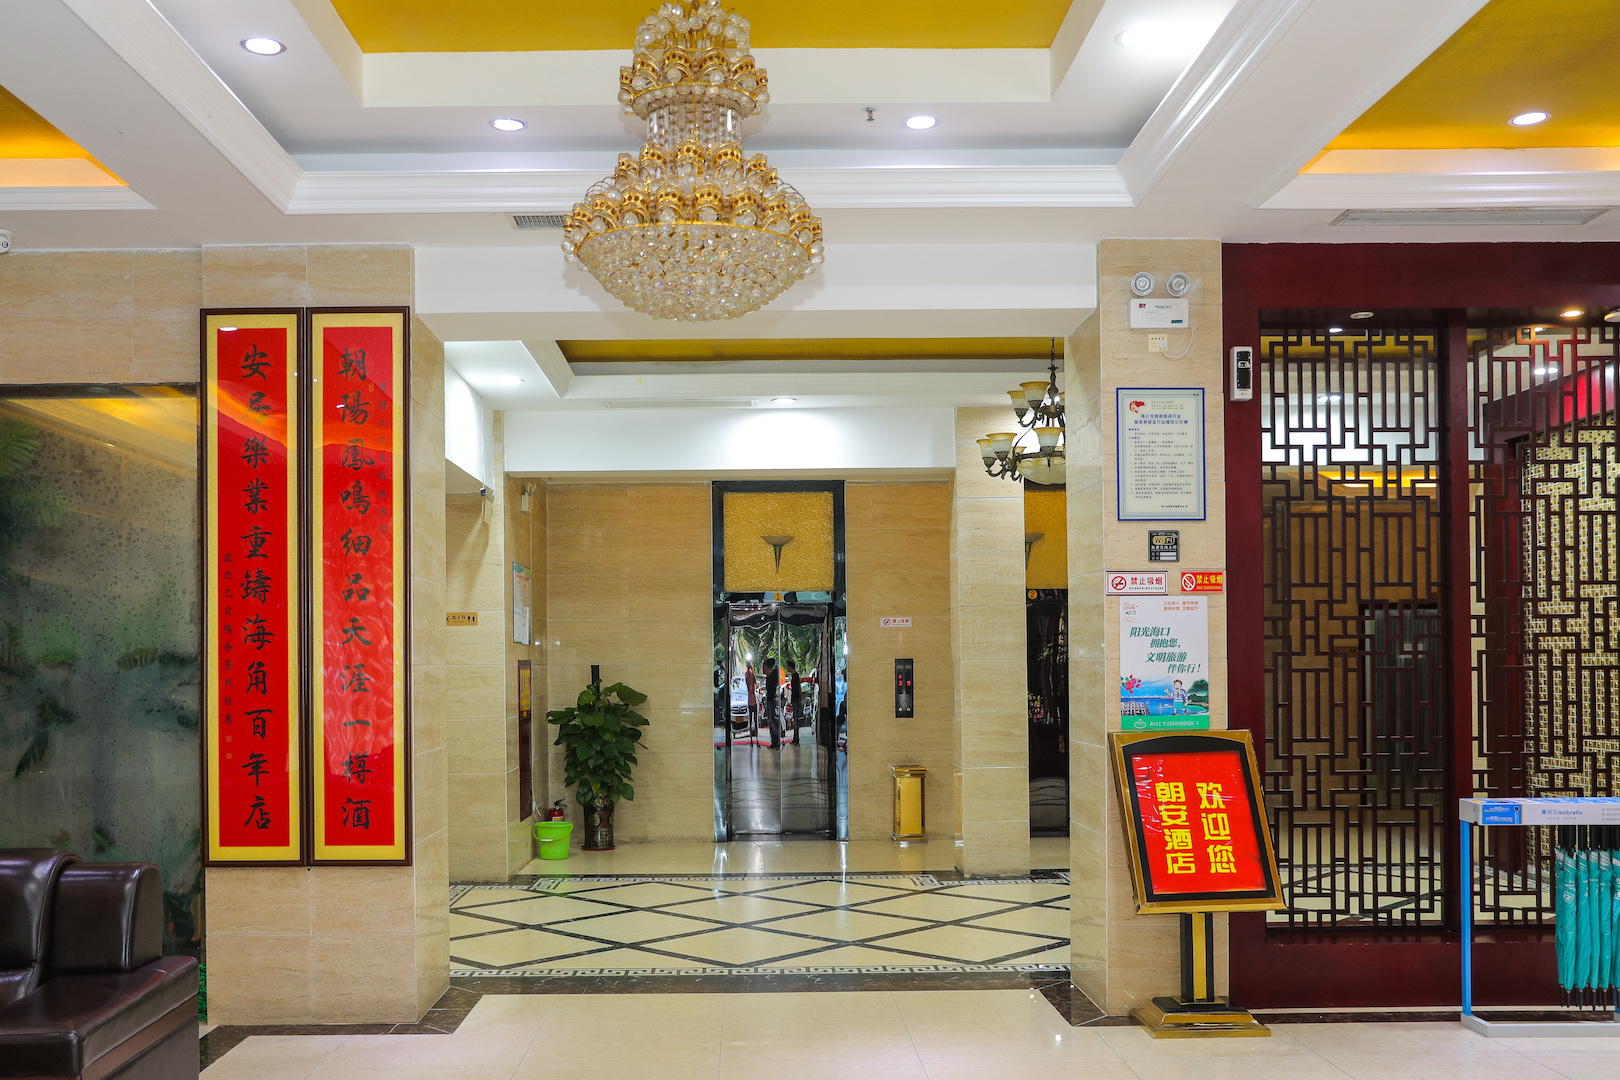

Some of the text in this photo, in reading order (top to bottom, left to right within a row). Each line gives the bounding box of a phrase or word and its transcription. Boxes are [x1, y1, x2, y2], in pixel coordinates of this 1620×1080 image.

[1130, 576, 1163, 586] 禁止吸烟
[1196, 575, 1222, 584] 禁止吸烟
[1129, 626, 1171, 637] 阳光海口
[1144, 651, 1188, 663] 文明旅游
[1154, 781, 1196, 874] 朝安酒店
[1195, 781, 1237, 874] 欢迎您
